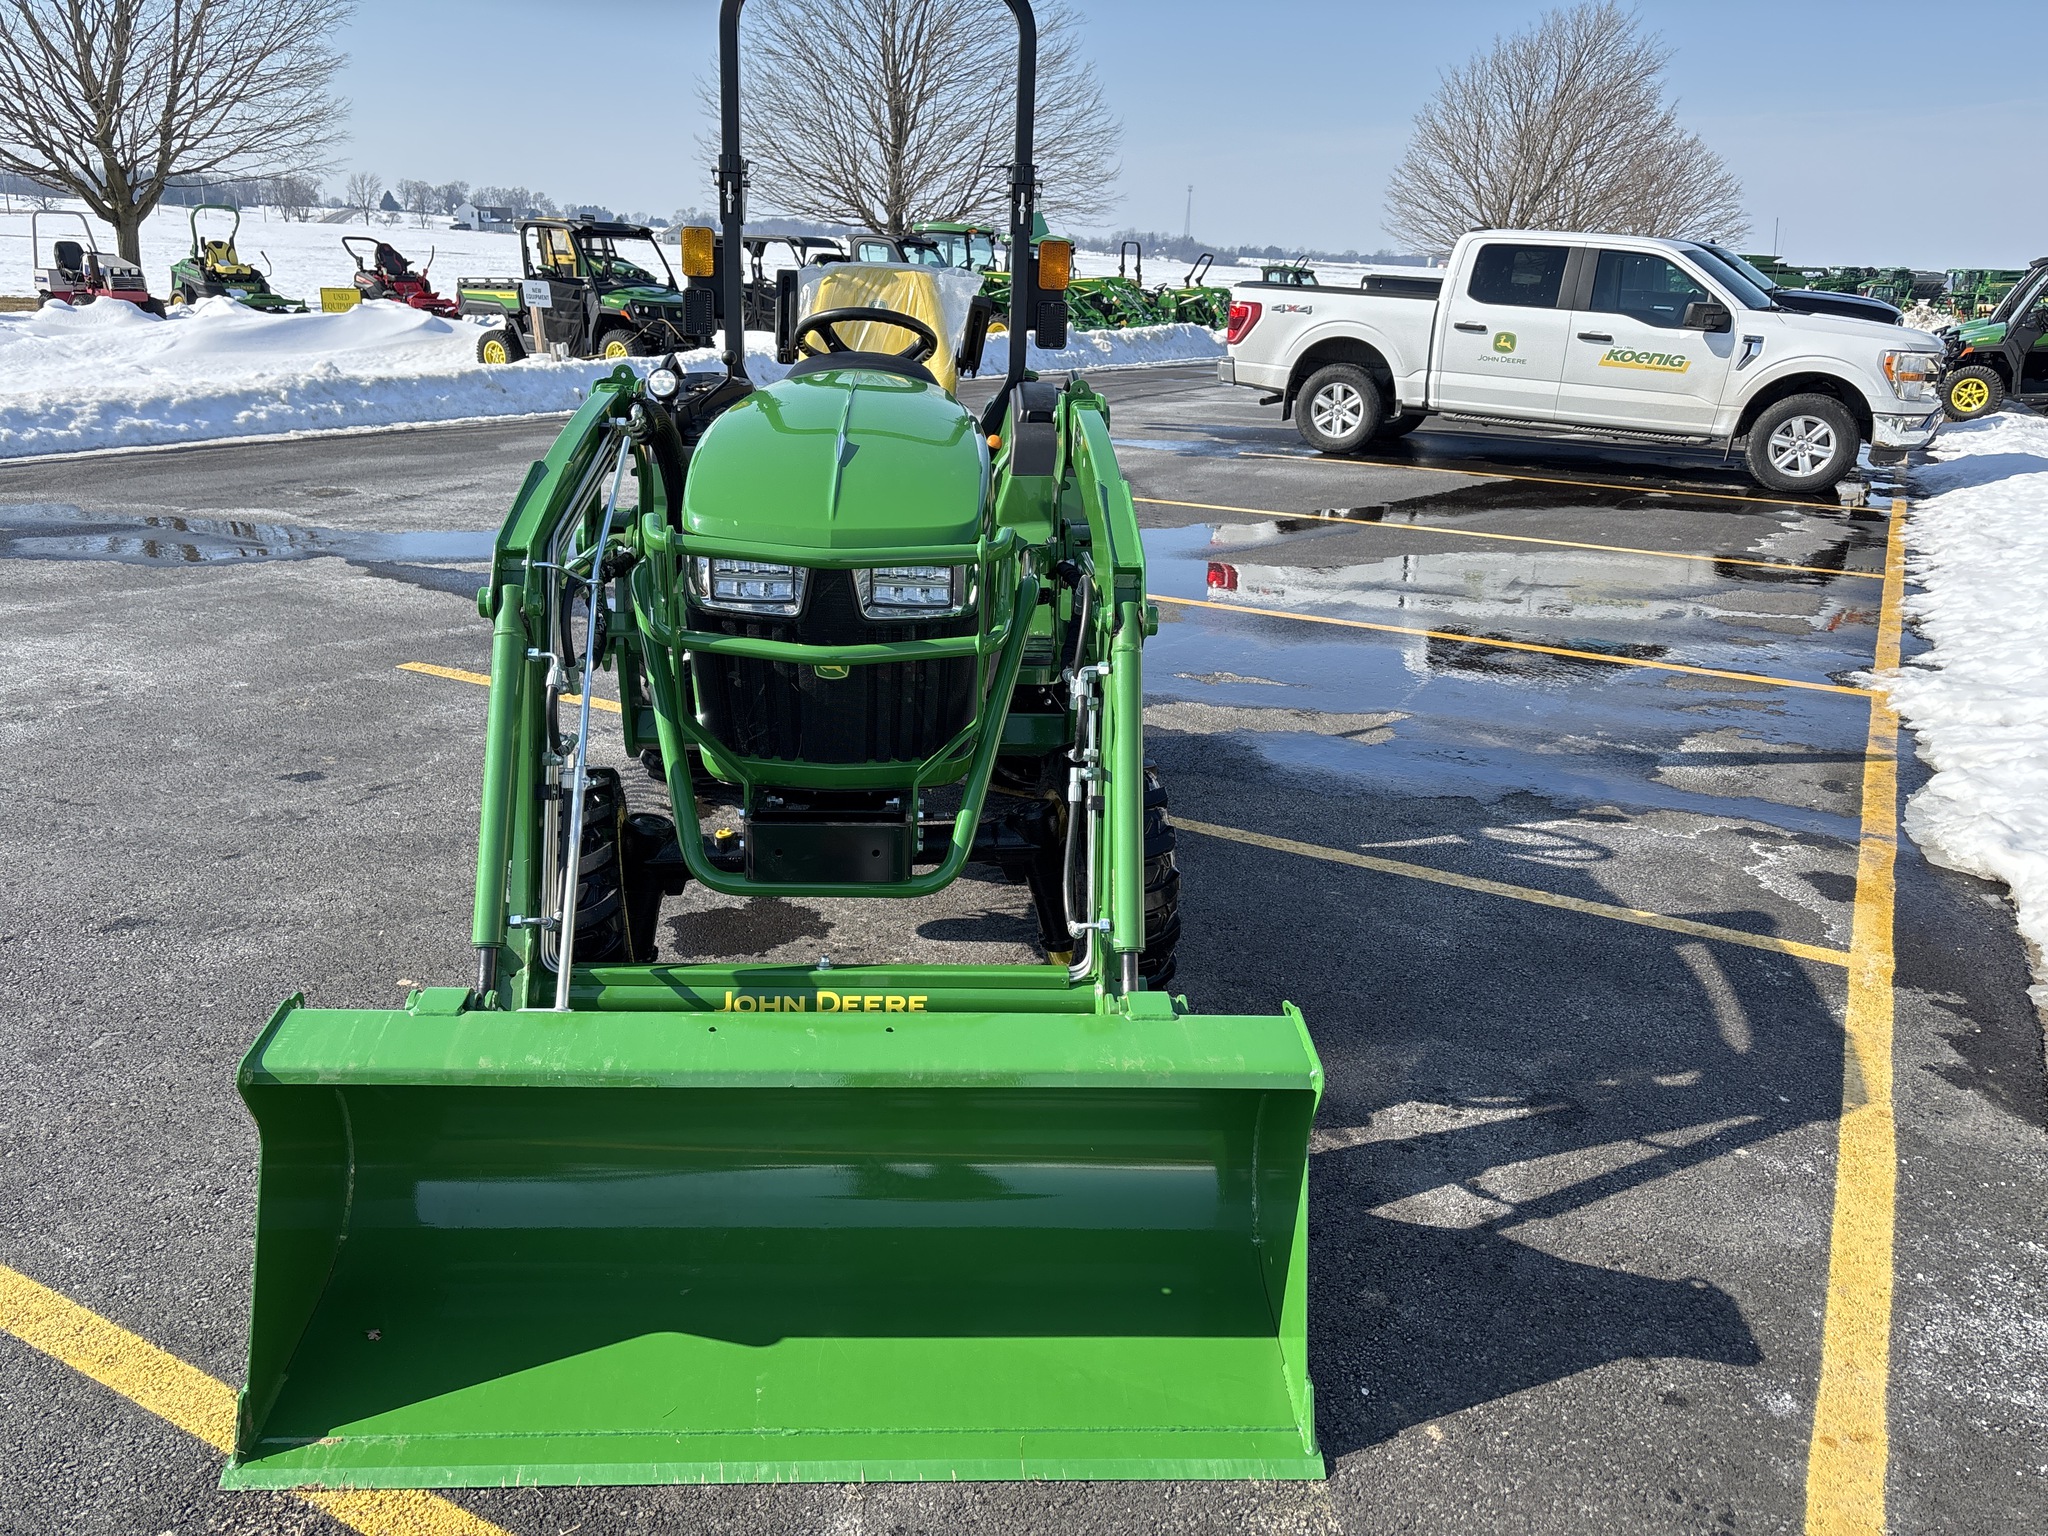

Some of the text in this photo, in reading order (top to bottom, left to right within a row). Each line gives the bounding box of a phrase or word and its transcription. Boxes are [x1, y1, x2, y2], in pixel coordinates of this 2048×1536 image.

[333, 293, 350, 301] USED
[324, 302, 355, 312] EQUIPME
[1477, 354, 1527, 365] JOHN DEERE
[714, 991, 928, 1013] JOHN DEERE
